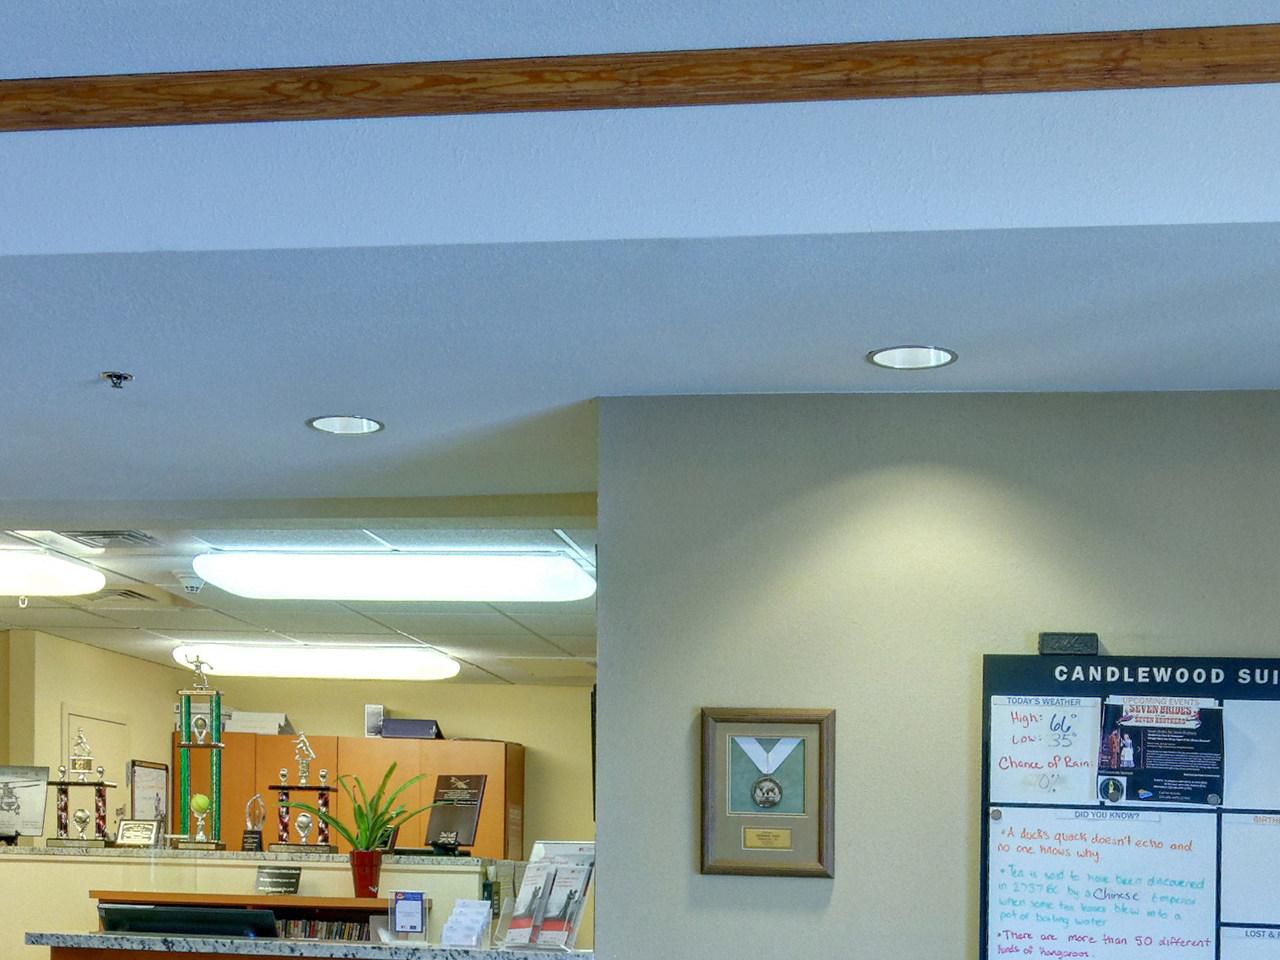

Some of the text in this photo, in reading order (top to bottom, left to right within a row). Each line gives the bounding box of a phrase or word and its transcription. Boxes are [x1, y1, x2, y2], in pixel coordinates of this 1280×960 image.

[1054, 665, 1225, 684] CANDLEWOOD
[1007, 697, 1081, 706] TODAY'S WEATHER
[1168, 698, 1201, 706] EVENTS
[1128, 704, 1192, 715] SEVEN BRIDES
[1010, 711, 1043, 729] High:
[1011, 734, 1042, 745] Low:
[998, 755, 1044, 769] Chance
[1047, 755, 1061, 769] of
[1074, 811, 1140, 820] DID YOU KNOW?
[1054, 832, 1088, 845] quack
[1134, 838, 1163, 850] echo
[1169, 839, 1192, 852] and
[997, 843, 1009, 852] no
[1016, 845, 1035, 854] one
[1076, 848, 1099, 864] why
[1092, 887, 1140, 901] Chinese
[1040, 933, 1058, 941] are
[1067, 934, 1097, 944] more
[1103, 934, 1128, 946] than
[1158, 937, 1212, 948] different
[1245, 930, 1266, 938] LOST
